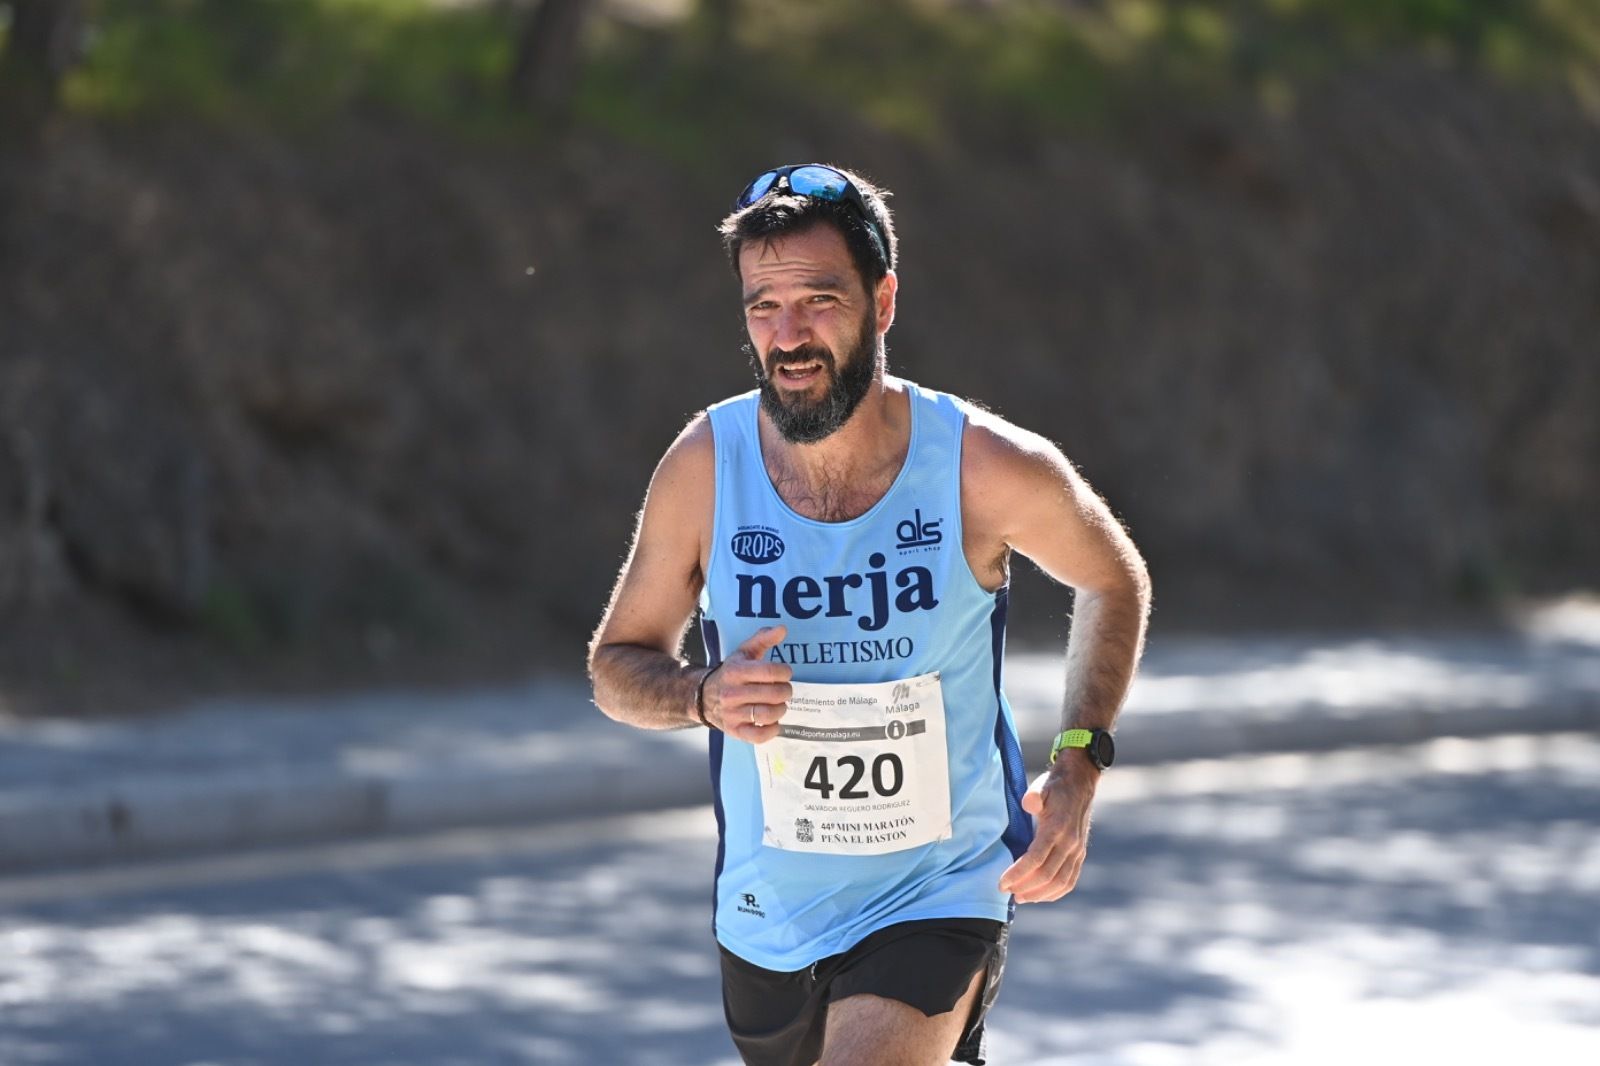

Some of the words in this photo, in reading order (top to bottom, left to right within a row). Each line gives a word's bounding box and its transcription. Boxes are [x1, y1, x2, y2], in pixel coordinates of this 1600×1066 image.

[732, 533, 782, 558] TROPS
[735, 552, 940, 631] nerja
[770, 636, 914, 664] ATLETISMO
[837, 696, 847, 705] de
[849, 696, 878, 705] Málaga
[885, 701, 920, 714] Málaga
[804, 752, 904, 799] 420
[804, 804, 838, 812] SALVADOR
[837, 822, 861, 831] MINI
[863, 815, 915, 831] MARATÓN
[821, 832, 848, 843] PEÑA
[851, 834, 864, 843] EL
